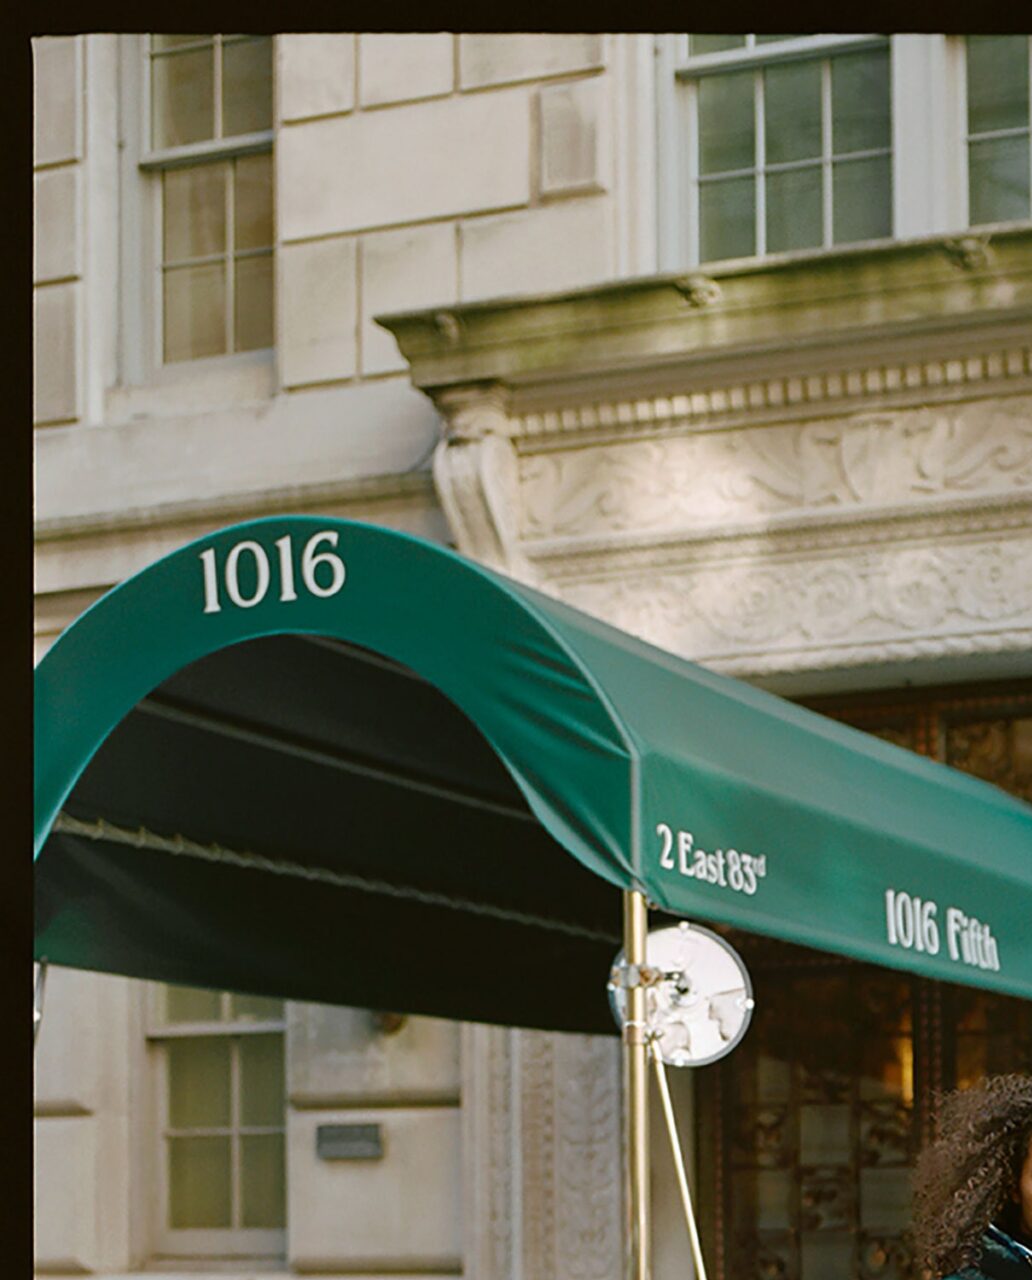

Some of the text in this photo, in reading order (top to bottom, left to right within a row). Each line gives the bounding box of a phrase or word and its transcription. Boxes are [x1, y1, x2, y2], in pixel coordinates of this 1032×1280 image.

[199, 530, 346, 613] 1016
[656, 823, 767, 896] 2 East 83rd
[886, 889, 1000, 971] 1016 Fifth
